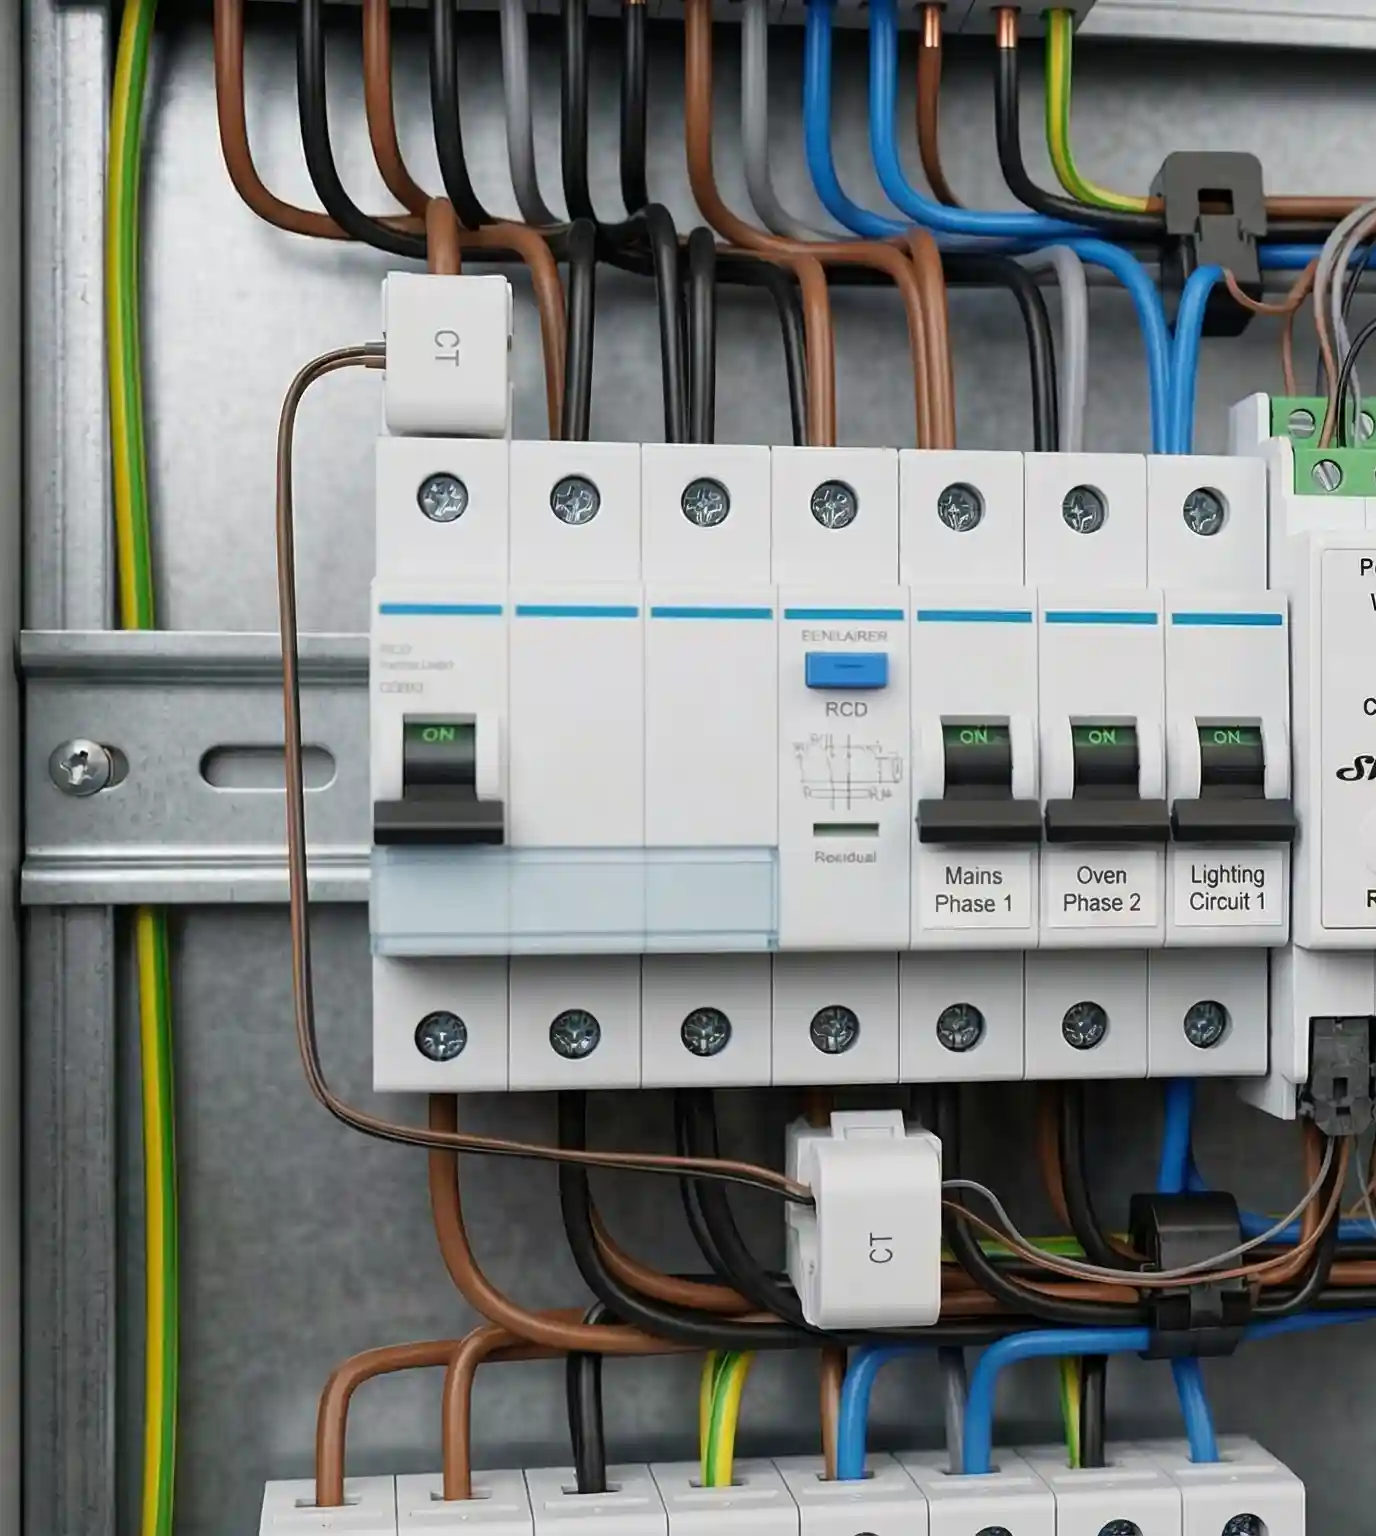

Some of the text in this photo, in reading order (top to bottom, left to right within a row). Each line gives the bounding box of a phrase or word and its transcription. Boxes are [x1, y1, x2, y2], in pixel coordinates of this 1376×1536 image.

[433, 329, 461, 367] CT
[826, 702, 867, 717] RCD
[422, 727, 454, 741] ON
[960, 729, 988, 744] ON
[1088, 729, 1117, 744] ON
[1214, 730, 1240, 744] ON
[946, 866, 1002, 885] Mains
[1077, 866, 1126, 884] Oven
[1192, 864, 1264, 888] Lighting
[936, 894, 1011, 912] Phase 1
[1064, 893, 1140, 911] Phase 2
[1190, 892, 1264, 910] Circuit 1
[868, 1232, 894, 1264] CT
